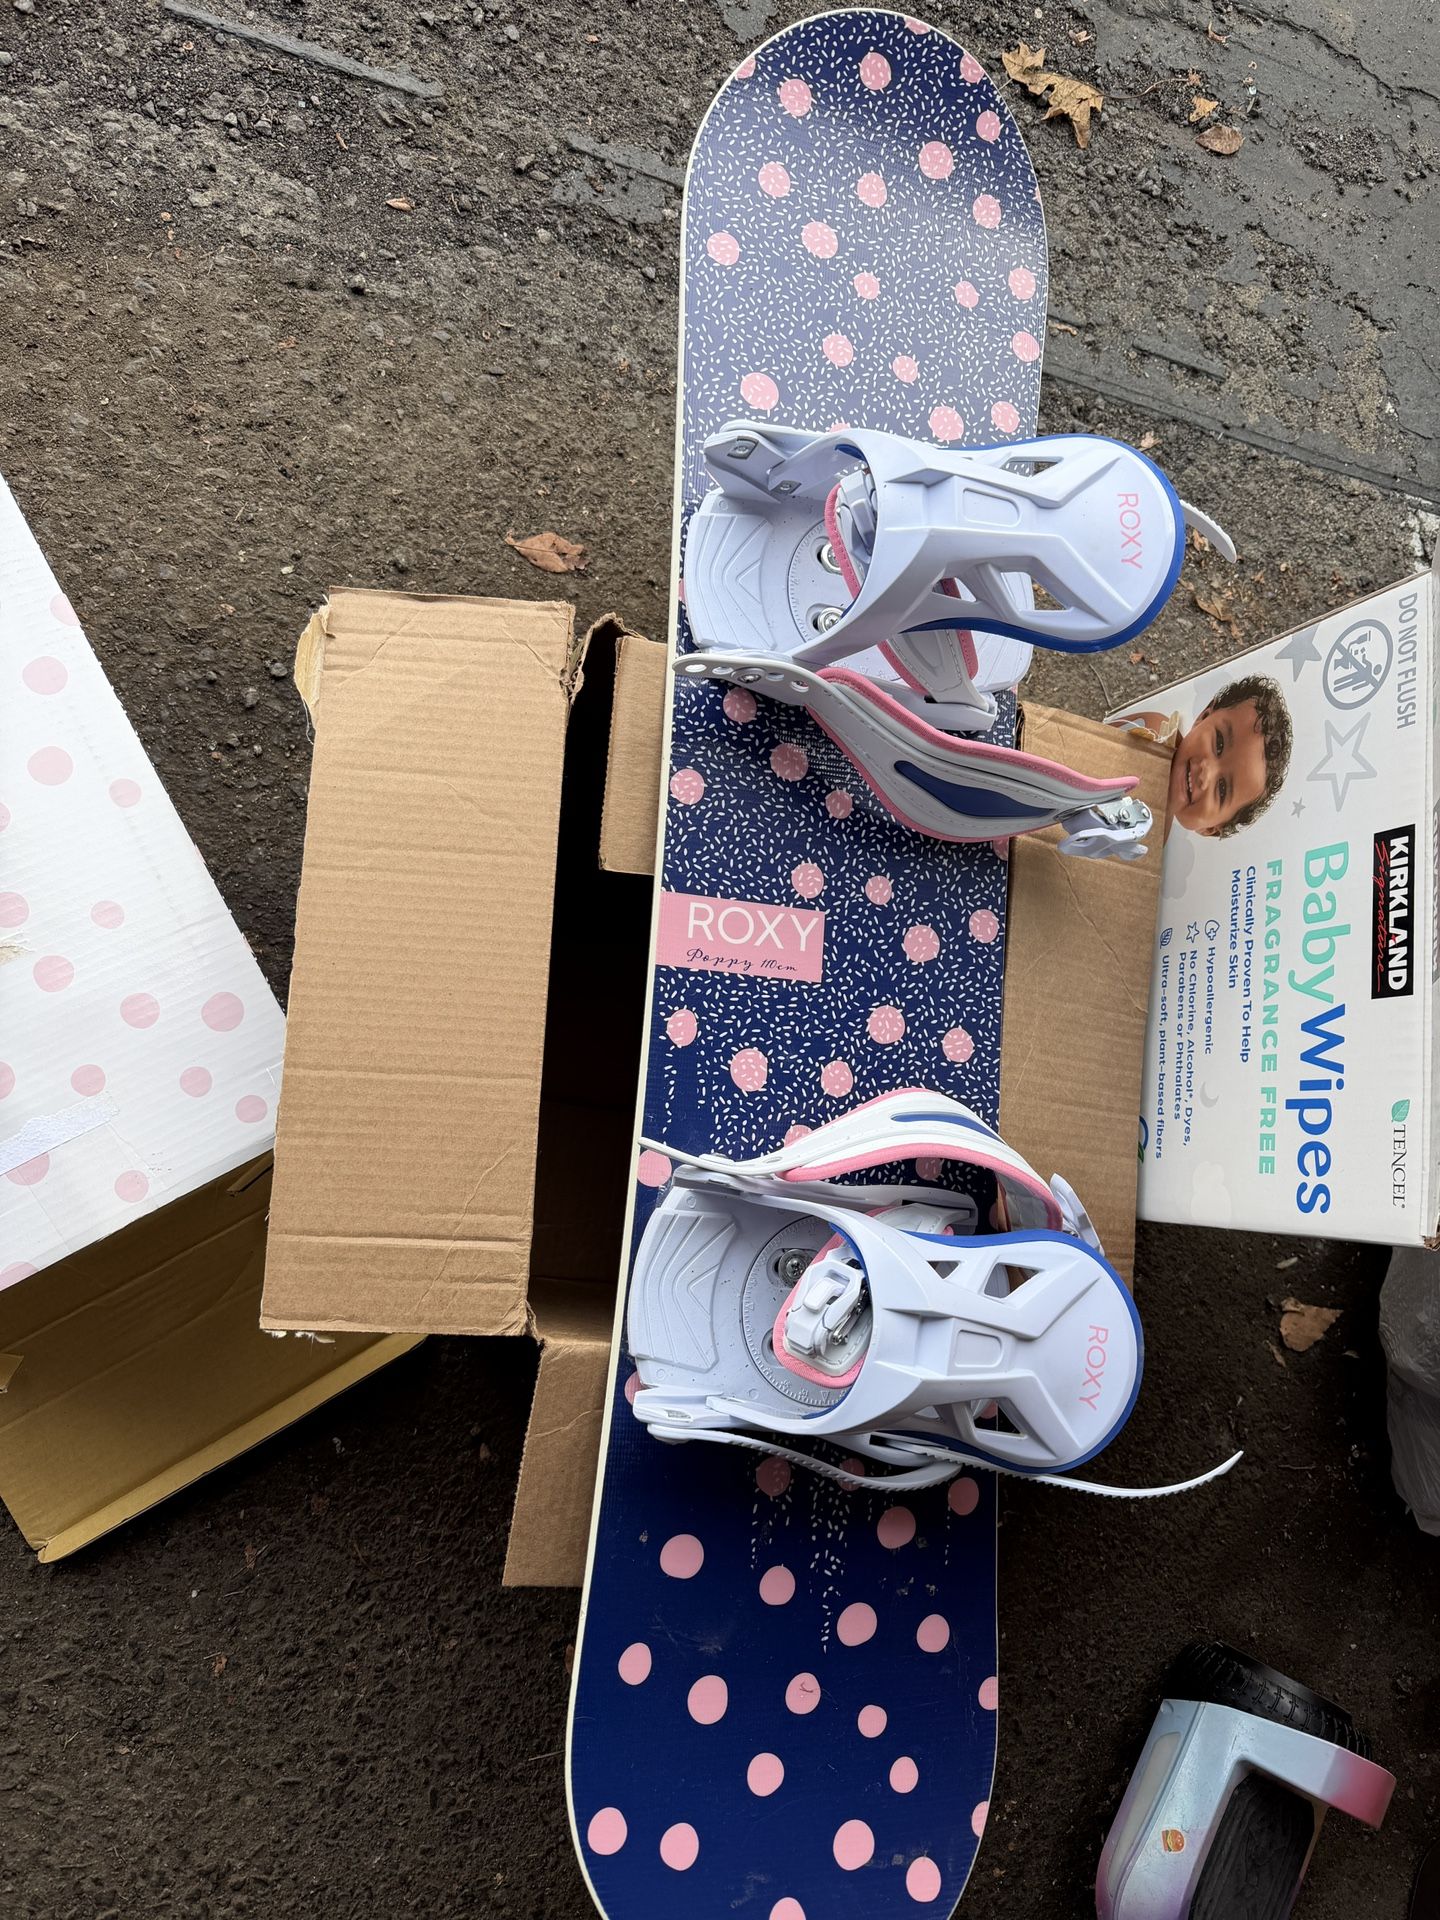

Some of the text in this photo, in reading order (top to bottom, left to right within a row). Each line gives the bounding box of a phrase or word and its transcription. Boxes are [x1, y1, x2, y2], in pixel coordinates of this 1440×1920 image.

[1117, 493, 1143, 570] ROXY
[1396, 592, 1418, 729] DO NOT FLUSH
[686, 948, 754, 971] Poppy
[687, 902, 819, 952] ROXY
[1189, 950, 1198, 969] No
[1228, 869, 1241, 989] Moisturize Skin
[1240, 865, 1256, 1063] Clinically Proven To Help
[1372, 841, 1390, 993] Signature
[1388, 835, 1409, 991] KIRKLAND
[1155, 955, 1170, 1159] Ultra-soft, plant-based fibers
[1174, 952, 1187, 1120] Parabens or Phthalates
[1187, 973, 1198, 1035] Chlorine,
[1204, 946, 1216, 1055] Hypoallergenic
[1258, 859, 1283, 1174] FRAGRANCE FREE
[1182, 1107, 1193, 1146] Dyes,
[1078, 1324, 1109, 1411] ROXY
